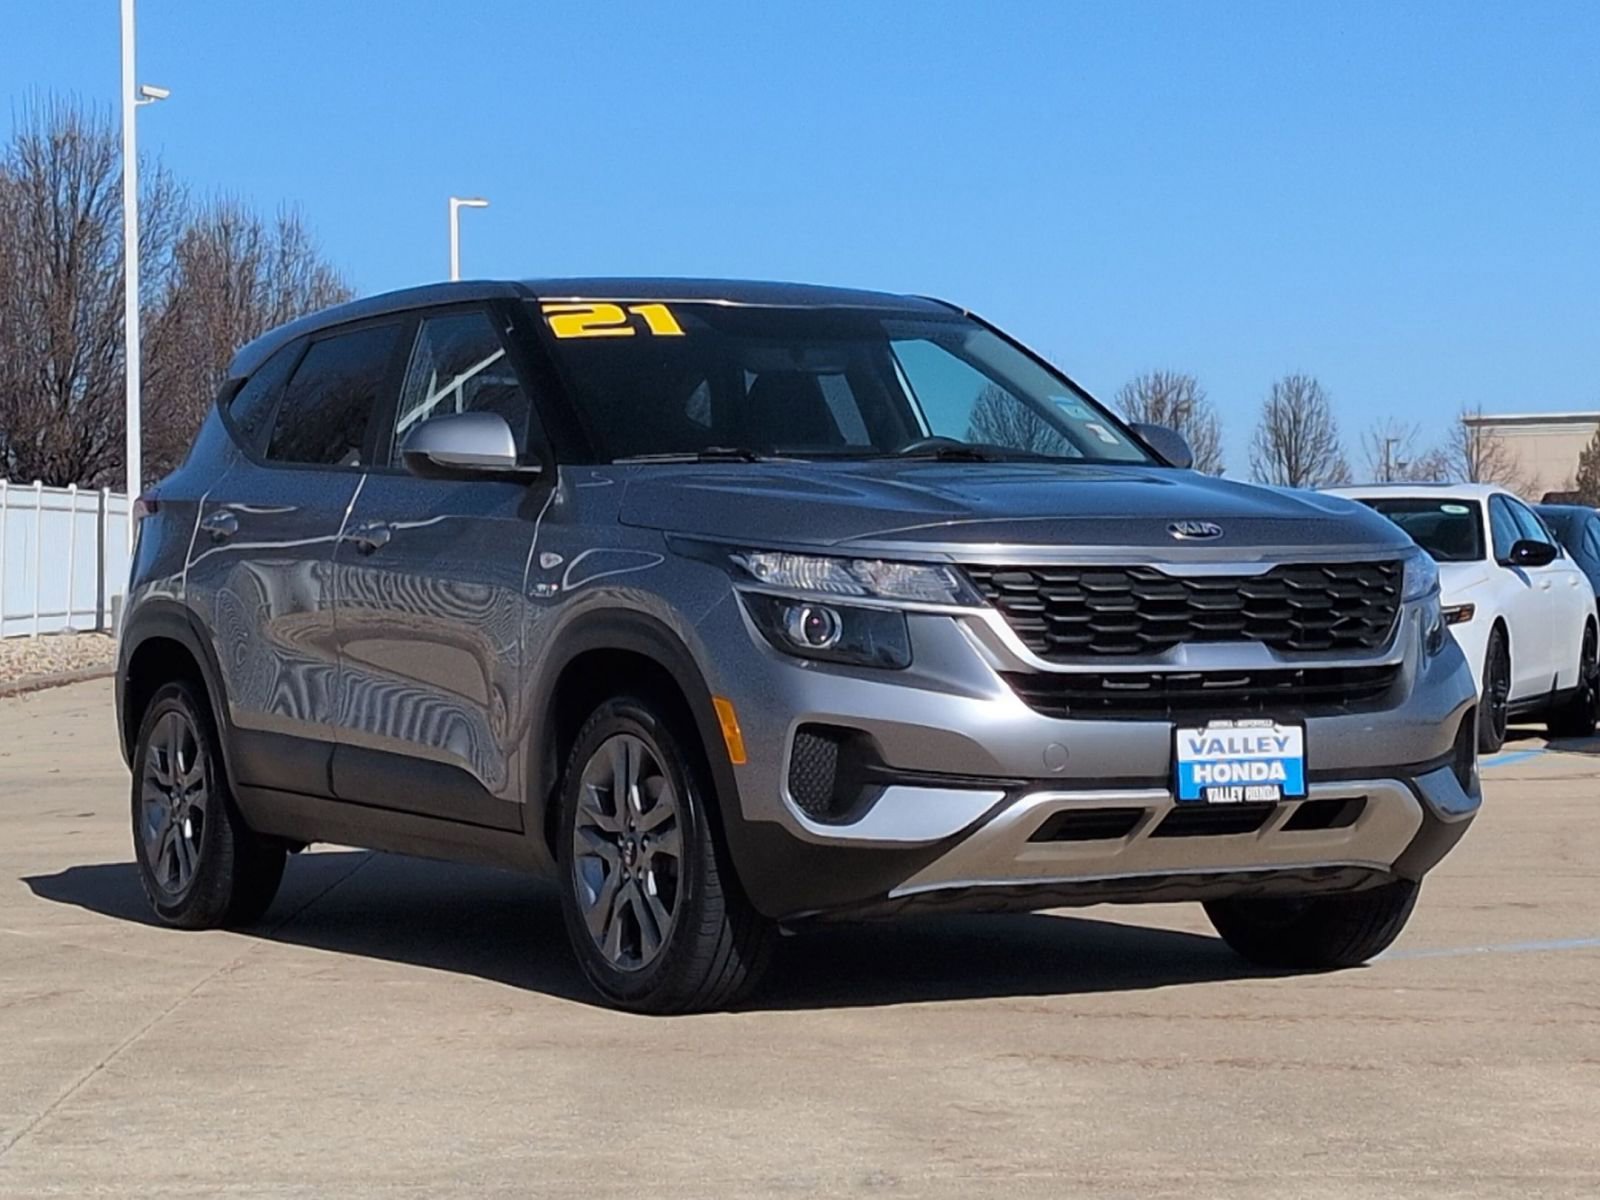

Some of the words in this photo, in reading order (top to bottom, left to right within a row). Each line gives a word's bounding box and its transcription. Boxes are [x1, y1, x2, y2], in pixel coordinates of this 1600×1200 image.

[541, 303, 686, 338] 21
[1187, 736, 1290, 755] VALLEY
[1193, 762, 1287, 784] HONDA
[1207, 786, 1243, 803] VALLEY
